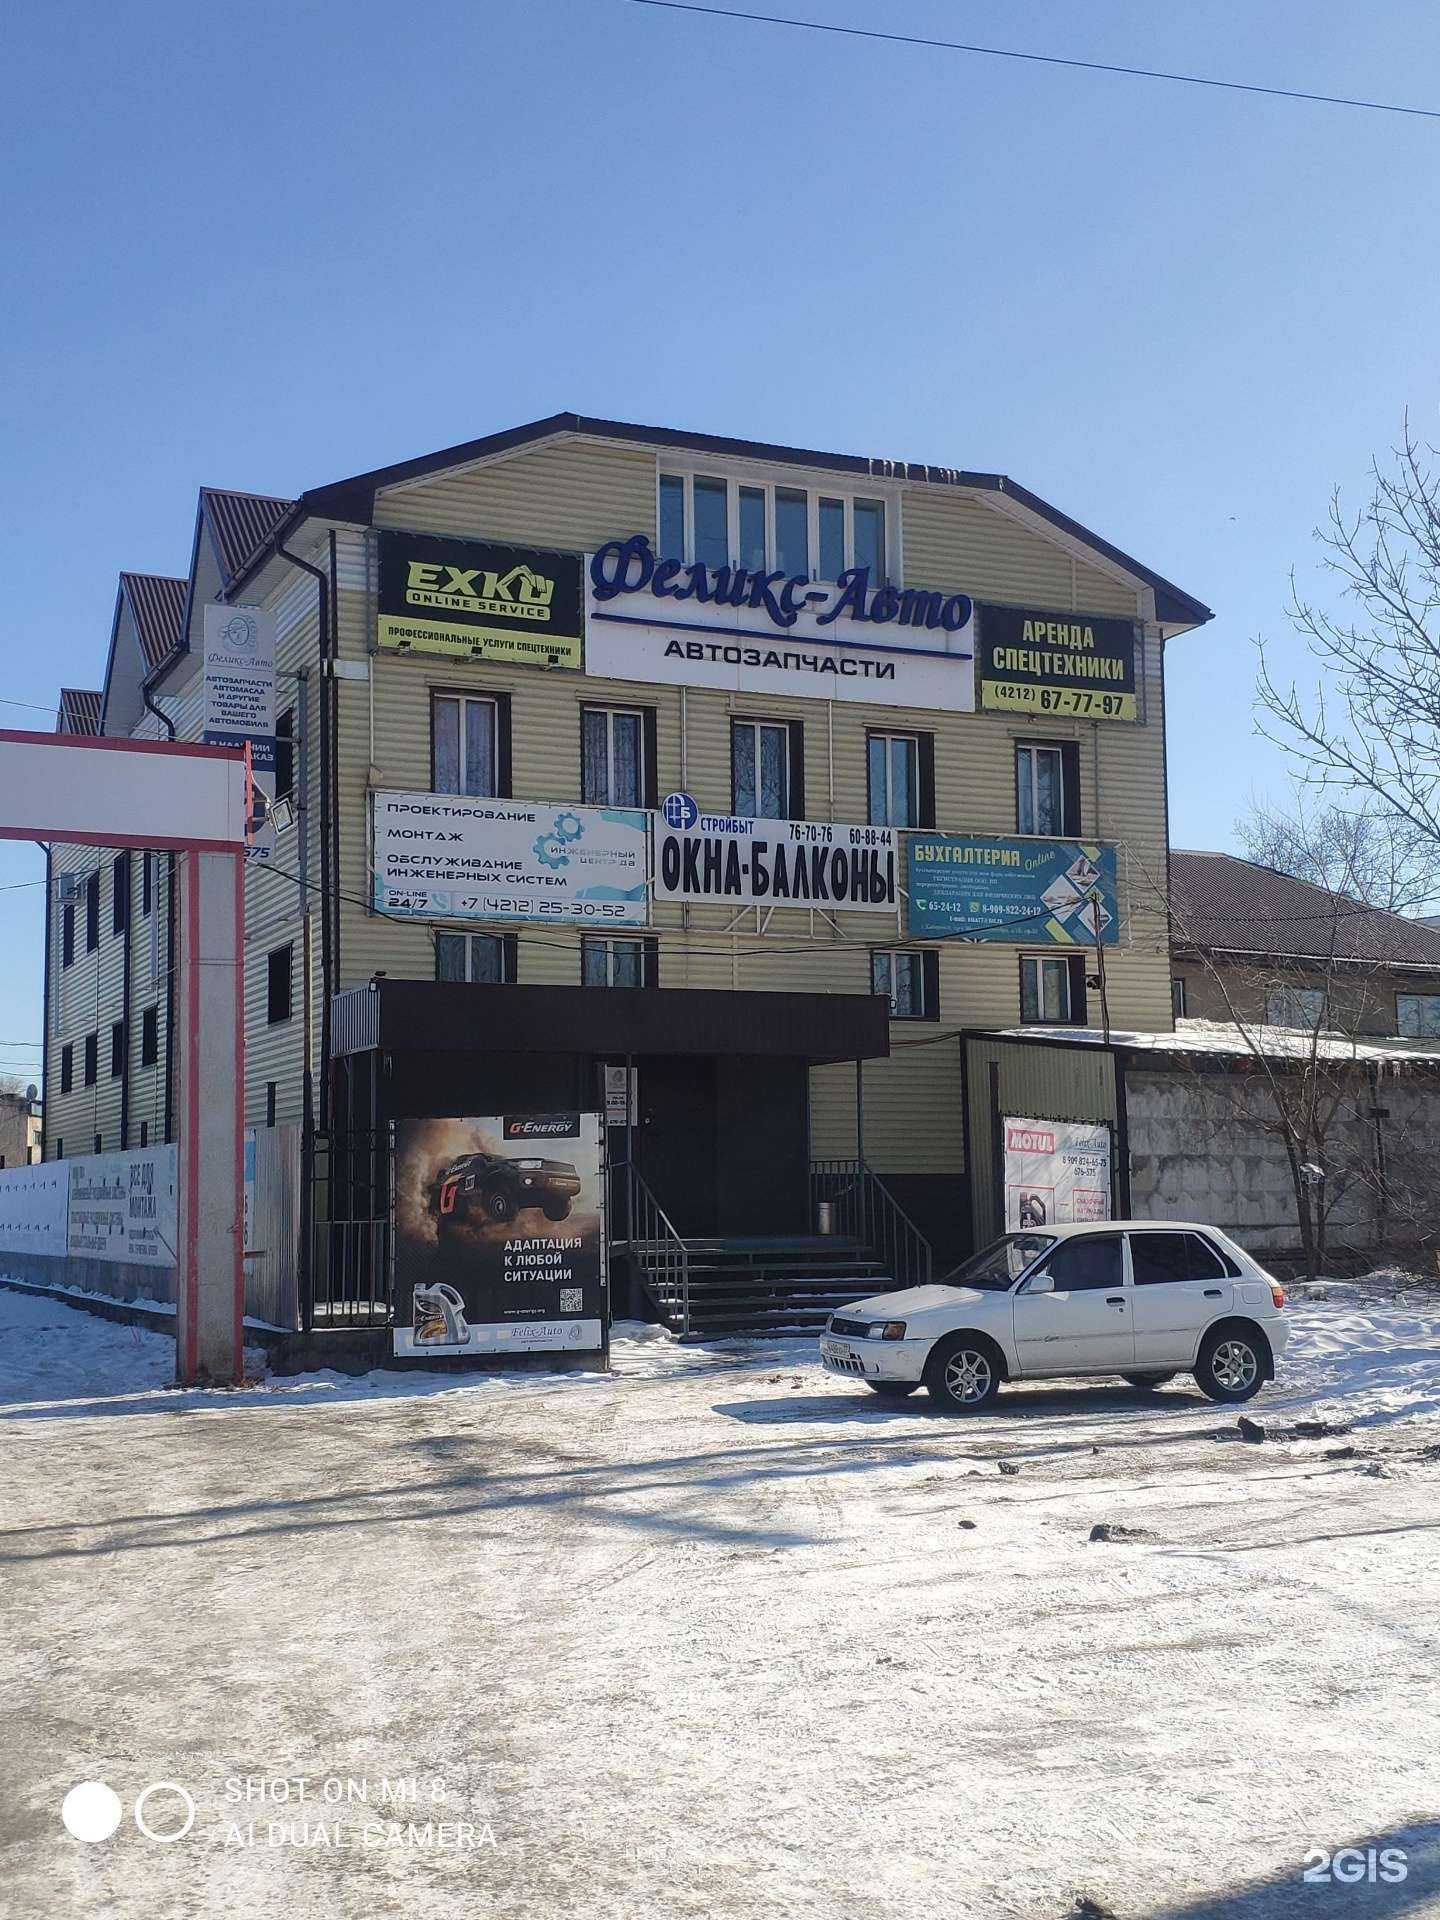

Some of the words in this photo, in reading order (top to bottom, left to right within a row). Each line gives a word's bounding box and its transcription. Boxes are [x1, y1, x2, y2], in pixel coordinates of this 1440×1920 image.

[590, 534, 972, 632] Феликс-Авто
[412, 593, 471, 608] ONLINE
[478, 602, 545, 617] SERVICE
[388, 626, 480, 646] ПРОФЕССИОНАЛЬНЫЕ
[483, 638, 514, 649] УСЛУГИ
[517, 641, 572, 656] СПЕЦТЕХНИКИ
[1022, 620, 1095, 650] АРЕНДА
[664, 640, 896, 679] АВТОЗАПЧАСТИ
[993, 647, 1124, 681] СПЕЦТЕХНИКИ
[206, 676, 273, 688] АВТОЗАПЧАСТИ
[213, 685, 265, 695] АВТОМАСЛА
[211, 701, 247, 710] ТОВАРЫ
[226, 694, 260, 702] ДРУГИЕ
[994, 685, 1036, 701] (4212)
[1040, 689, 1123, 715] 67-77-97
[209, 717, 268, 728] АВТОМОБИЛЯ
[221, 710, 256, 719] ВАШЕГО
[387, 803, 536, 822] ПРОЕКТИРОВАНИЕ
[701, 816, 754, 835] СТРОЙБЫТ
[790, 823, 833, 843] 76-70-76
[849, 828, 892, 846] 60-88-44
[387, 829, 463, 842] МОНТАЖ
[387, 854, 523, 870] ОБСЛУЖИВАНИЕ
[915, 844, 1020, 867] БУХГАЛТЕРИЯ
[1024, 850, 1056, 871] Online
[387, 869, 502, 883] ИНЖЕНЕРНЫХ
[506, 875, 567, 886] СИСТЕМ
[662, 836, 896, 903] ОКНА-БАЛКОНЫ
[388, 898, 427, 909] 24/7
[461, 898, 478, 909] +7
[539, 902, 625, 917] 25-30-52
[928, 901, 960, 912] 65-24-12
[1010, 1132, 1054, 1151] MOTUL
[504, 1237, 582, 1252] АДАПТАЦИЯ
[504, 1255, 513, 1267] К
[515, 1252, 562, 1267] ЛЮБОЙ
[504, 1268, 572, 1282] СИТУАЦИИ
